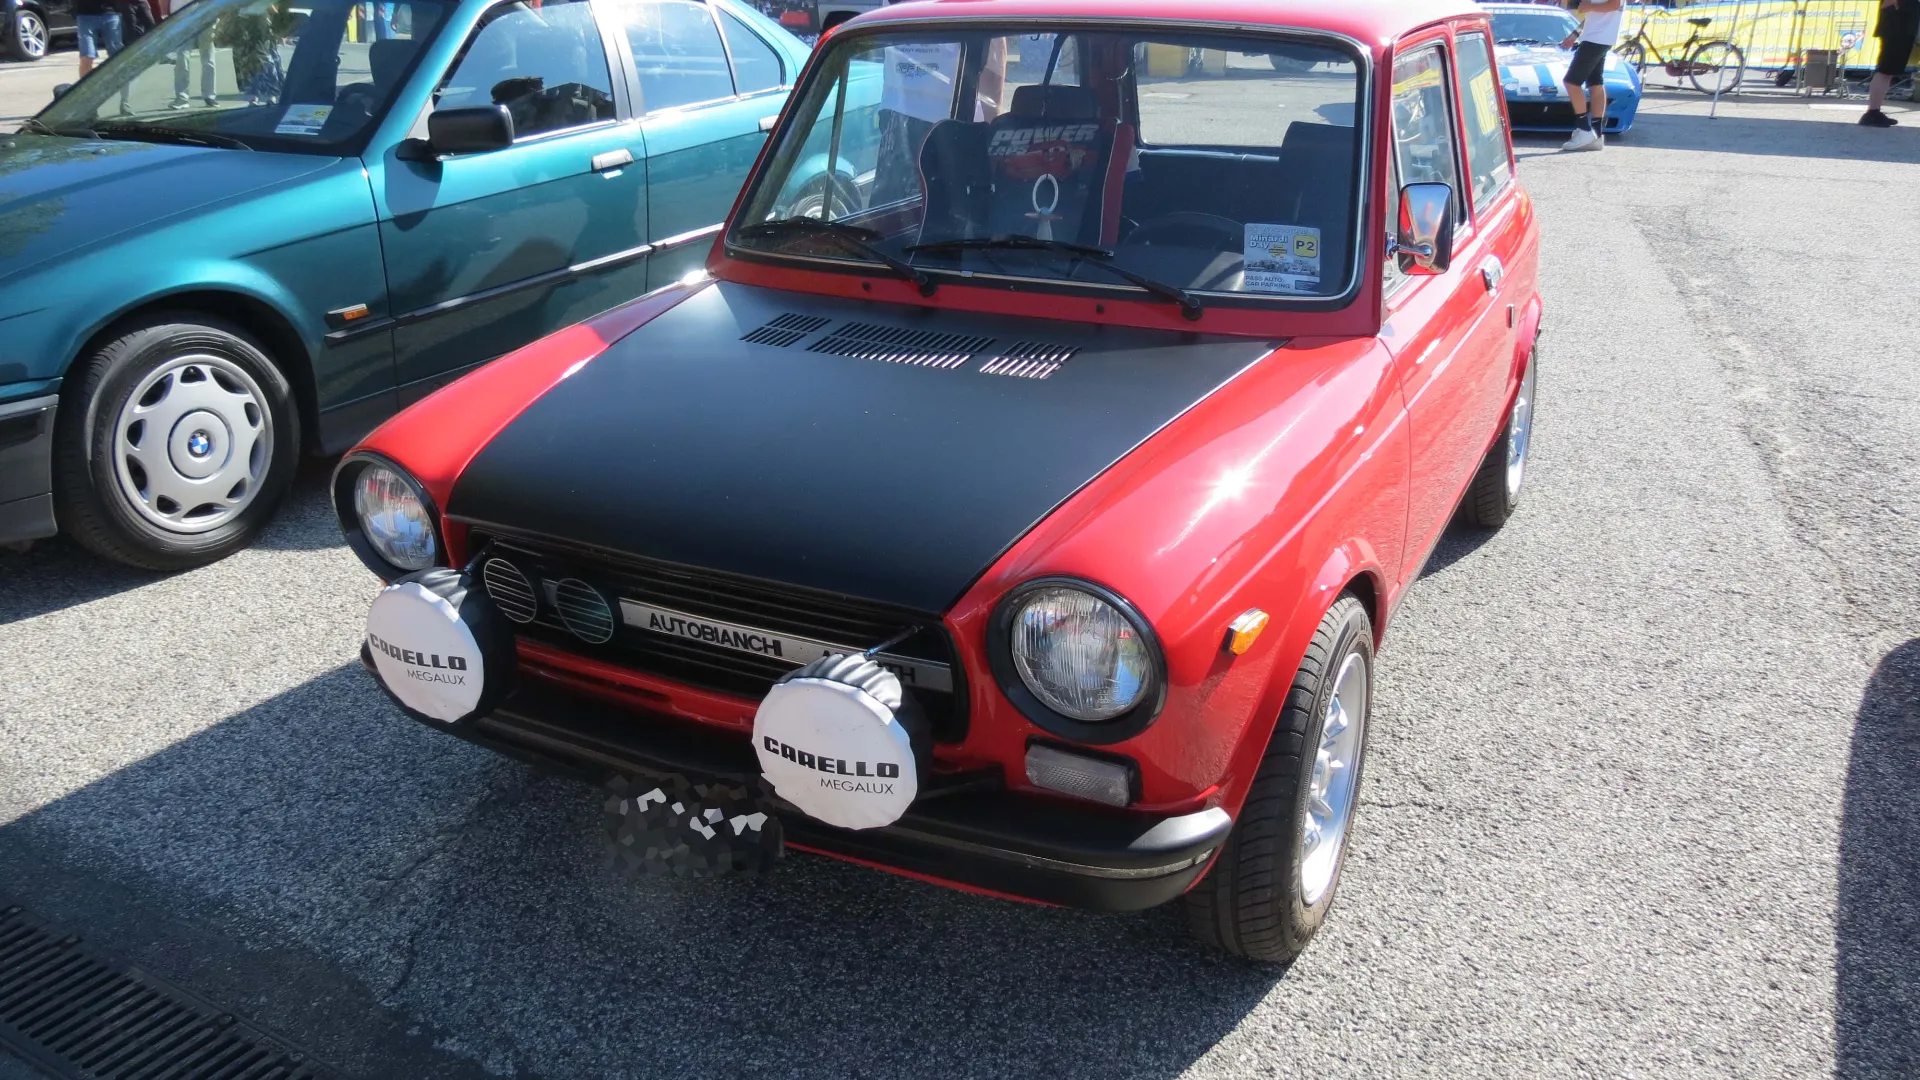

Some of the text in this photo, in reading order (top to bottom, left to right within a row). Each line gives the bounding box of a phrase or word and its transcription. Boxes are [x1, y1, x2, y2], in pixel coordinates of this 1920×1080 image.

[991, 124, 1099, 147] POWER
[1250, 234, 1289, 244] Minardi
[1250, 241, 1270, 250] Day
[1295, 240, 1315, 252] P2
[649, 612, 783, 657] AUTOBIANCHI
[369, 633, 467, 671] CARELLO
[406, 668, 467, 686] MEGALUX
[763, 735, 899, 779] CARELLO
[820, 777, 894, 795] MEGALUX
